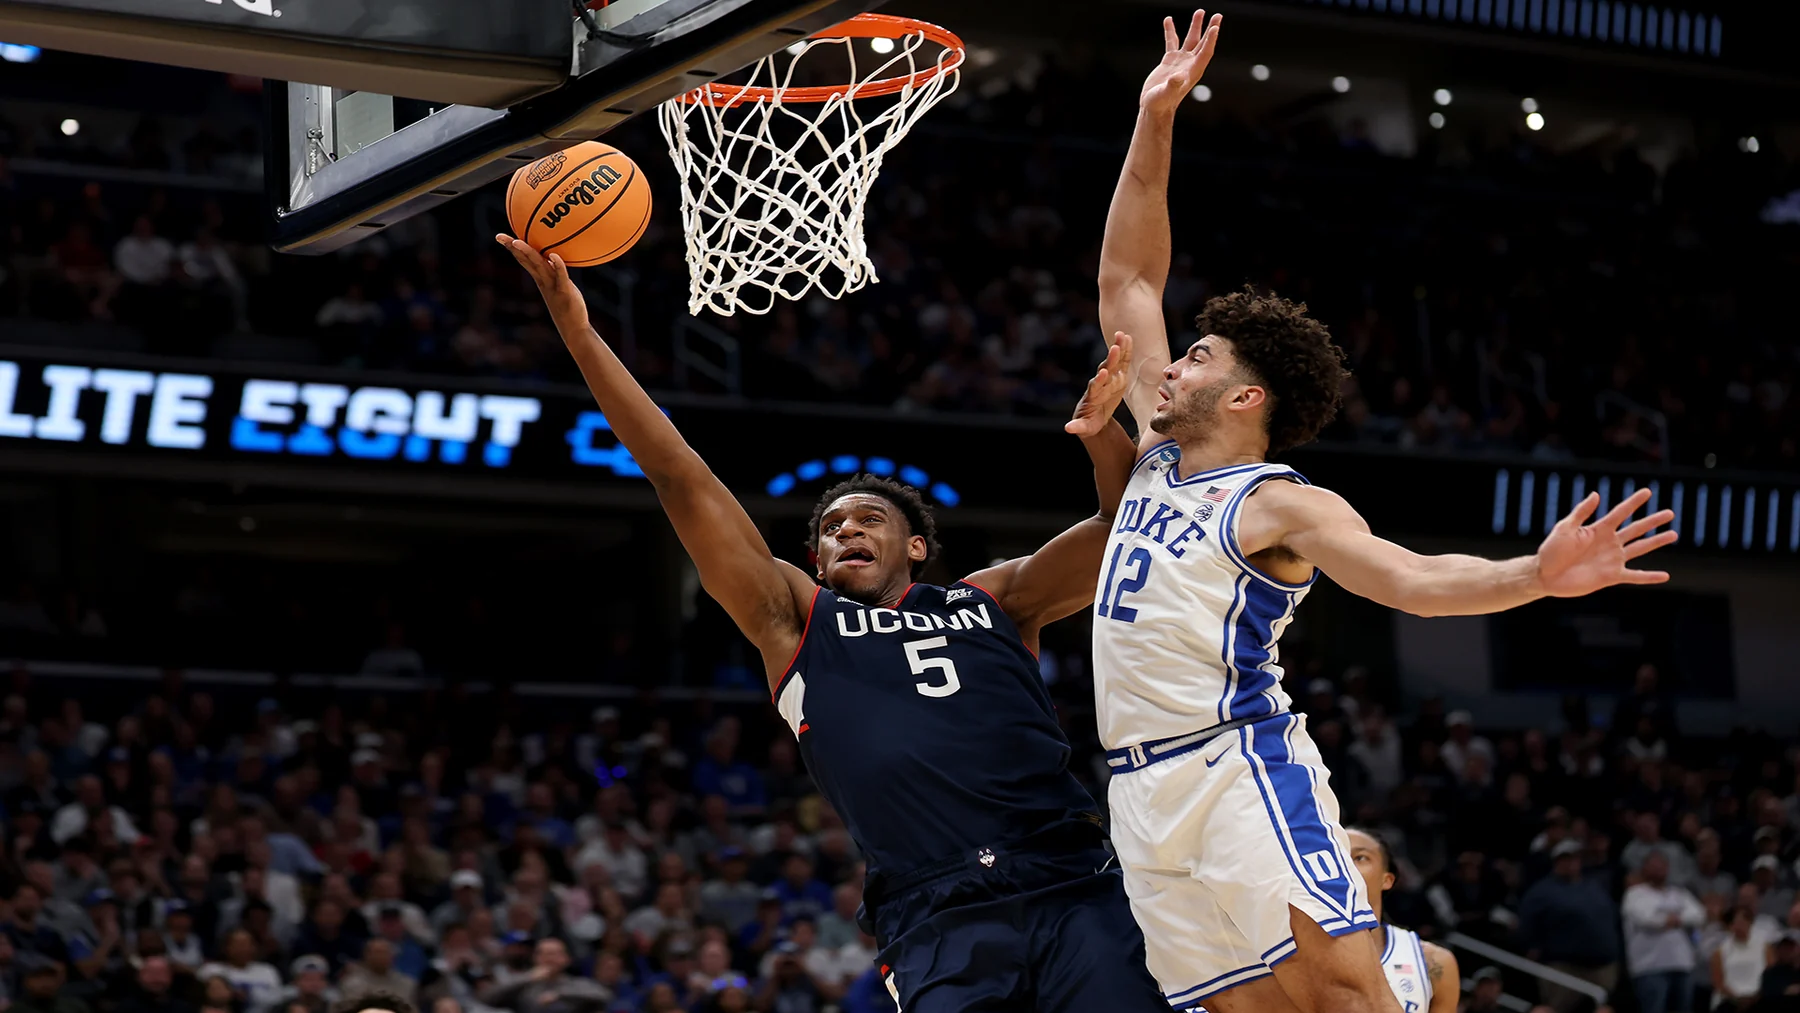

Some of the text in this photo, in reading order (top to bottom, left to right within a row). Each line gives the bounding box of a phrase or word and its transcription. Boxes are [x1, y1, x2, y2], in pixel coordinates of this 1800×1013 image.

[540, 165, 622, 229] Wilson
[229, 378, 542, 468] EIGHT
[1116, 497, 1207, 559] DUKE
[1098, 542, 1153, 623] 12
[836, 603, 993, 637] UCONN
[902, 635, 962, 698] 5
[1302, 850, 1341, 883] D
